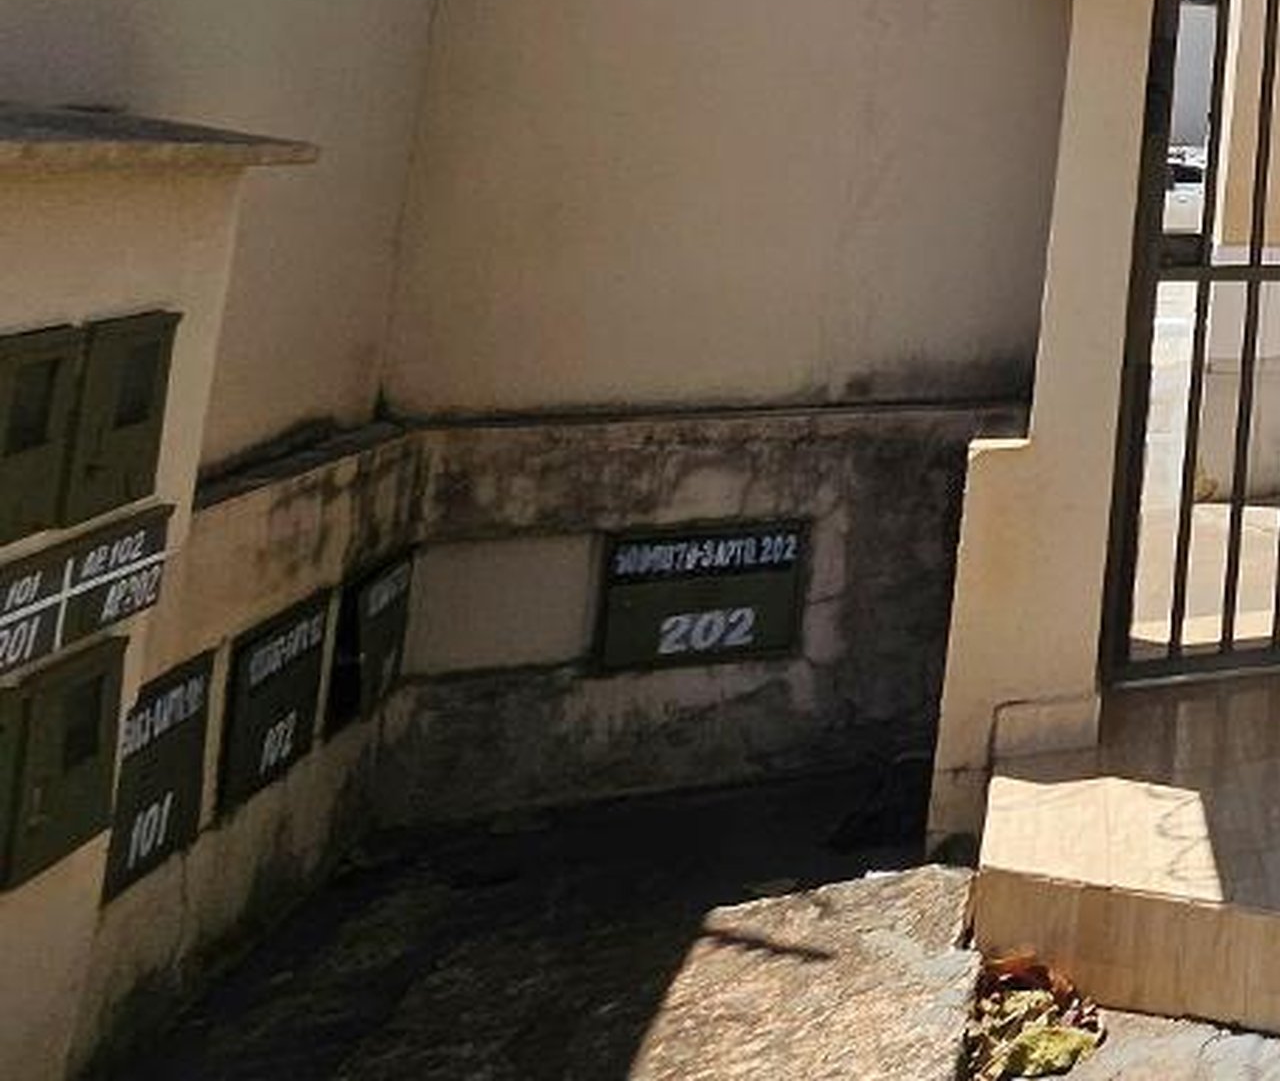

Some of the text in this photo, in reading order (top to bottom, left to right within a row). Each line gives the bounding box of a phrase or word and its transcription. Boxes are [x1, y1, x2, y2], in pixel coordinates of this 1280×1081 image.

[759, 533, 797, 564] 202
[4, 571, 42, 611] 101
[657, 607, 754, 655] 202
[127, 791, 173, 868] 101
